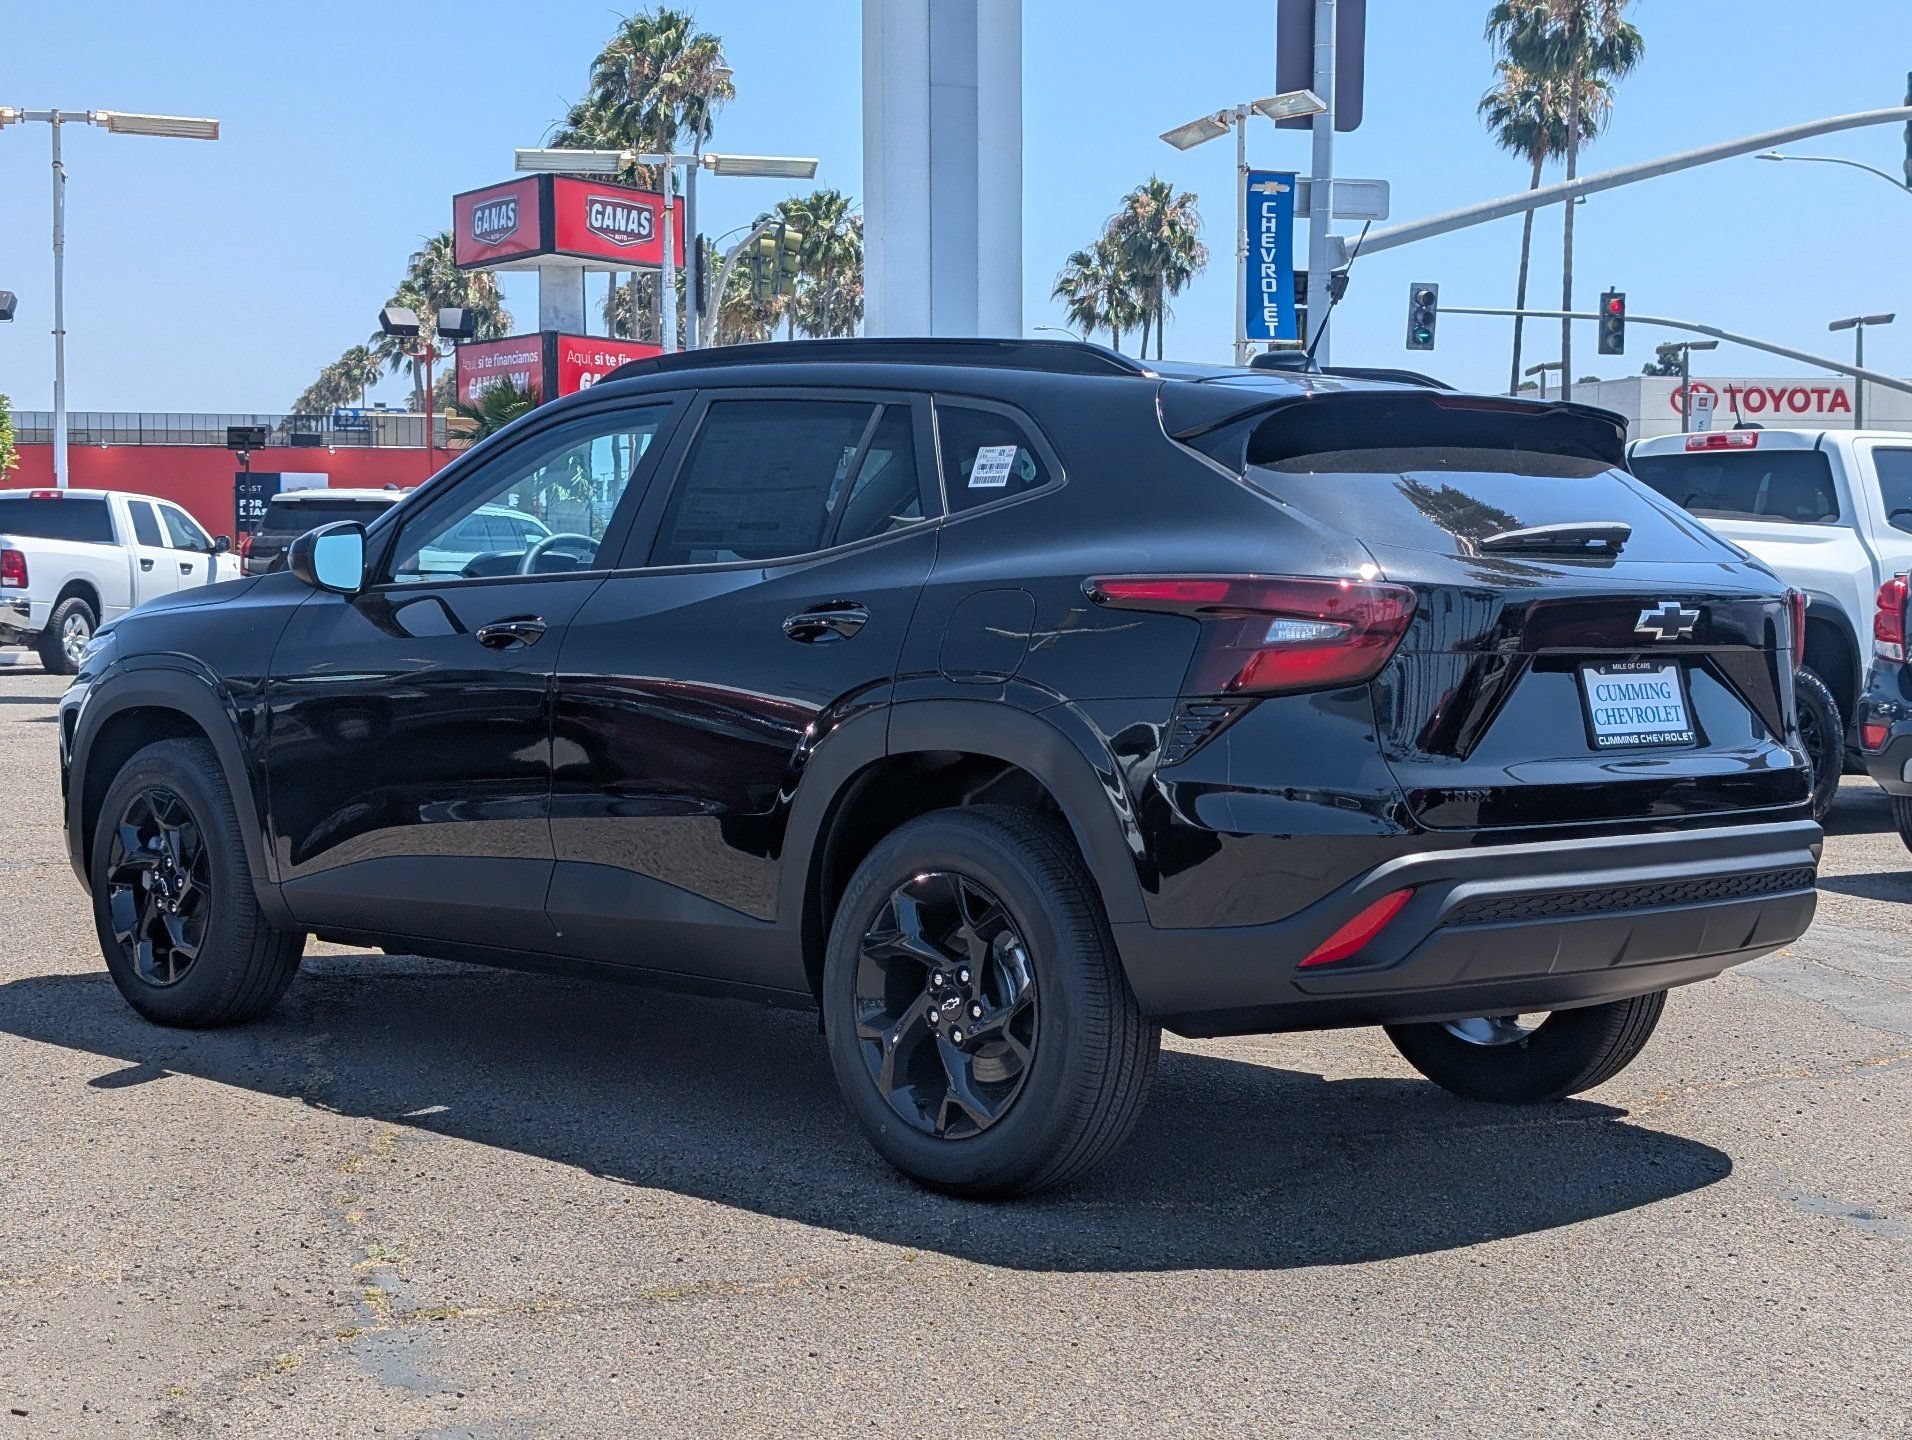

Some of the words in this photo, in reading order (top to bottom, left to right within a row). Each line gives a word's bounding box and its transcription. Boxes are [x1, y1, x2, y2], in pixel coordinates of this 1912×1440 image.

[474, 202, 516, 235] GANAS
[590, 203, 651, 236] GANAS
[1260, 202, 1279, 337] CHEVROLET
[485, 354, 493, 368] te
[493, 349, 539, 367] financiamos
[567, 349, 593, 367] Aquí,
[594, 351, 604, 366] sí
[605, 353, 617, 367] te
[1723, 386, 1852, 413] TOYOTA
[240, 484, 262, 492] CST
[240, 499, 262, 507] FOR
[1636, 662, 1651, 670] CARS
[1596, 682, 1671, 701] CUMMING
[1594, 704, 1681, 726] CHEVROLET
[1598, 735, 1640, 746] CUMMING
[1640, 731, 1694, 744] CHEVROLET
